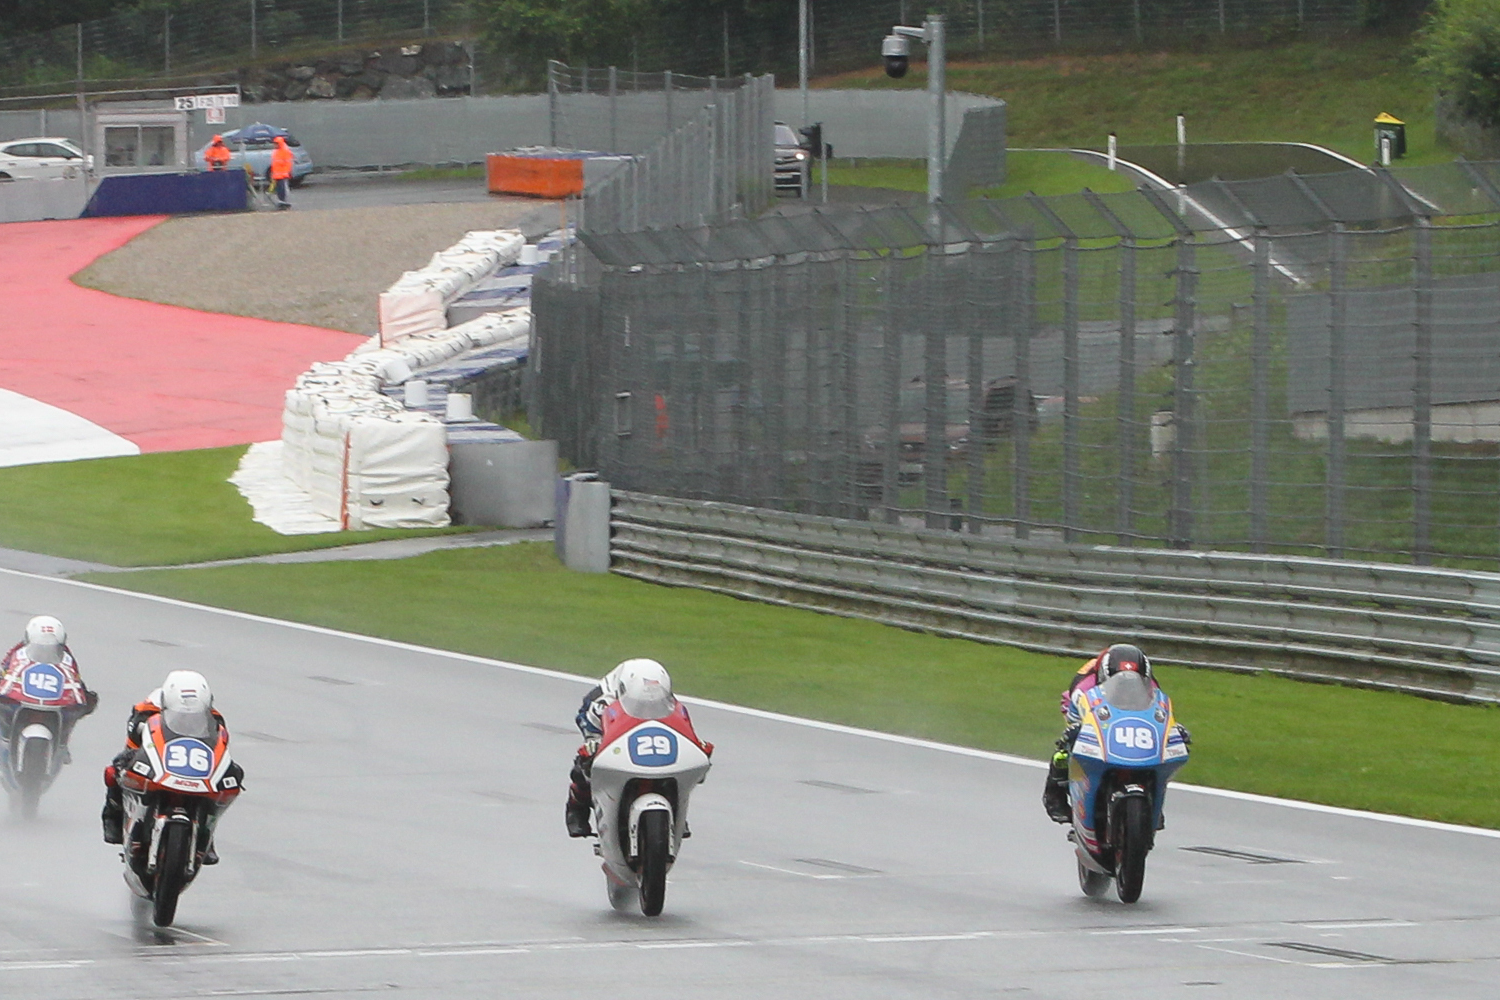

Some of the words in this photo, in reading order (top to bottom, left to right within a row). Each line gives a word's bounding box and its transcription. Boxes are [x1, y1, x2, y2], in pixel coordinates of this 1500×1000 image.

[29, 672, 58, 693] 42
[636, 735, 671, 756] 29
[1114, 727, 1154, 750] 48
[167, 745, 209, 772] 36
